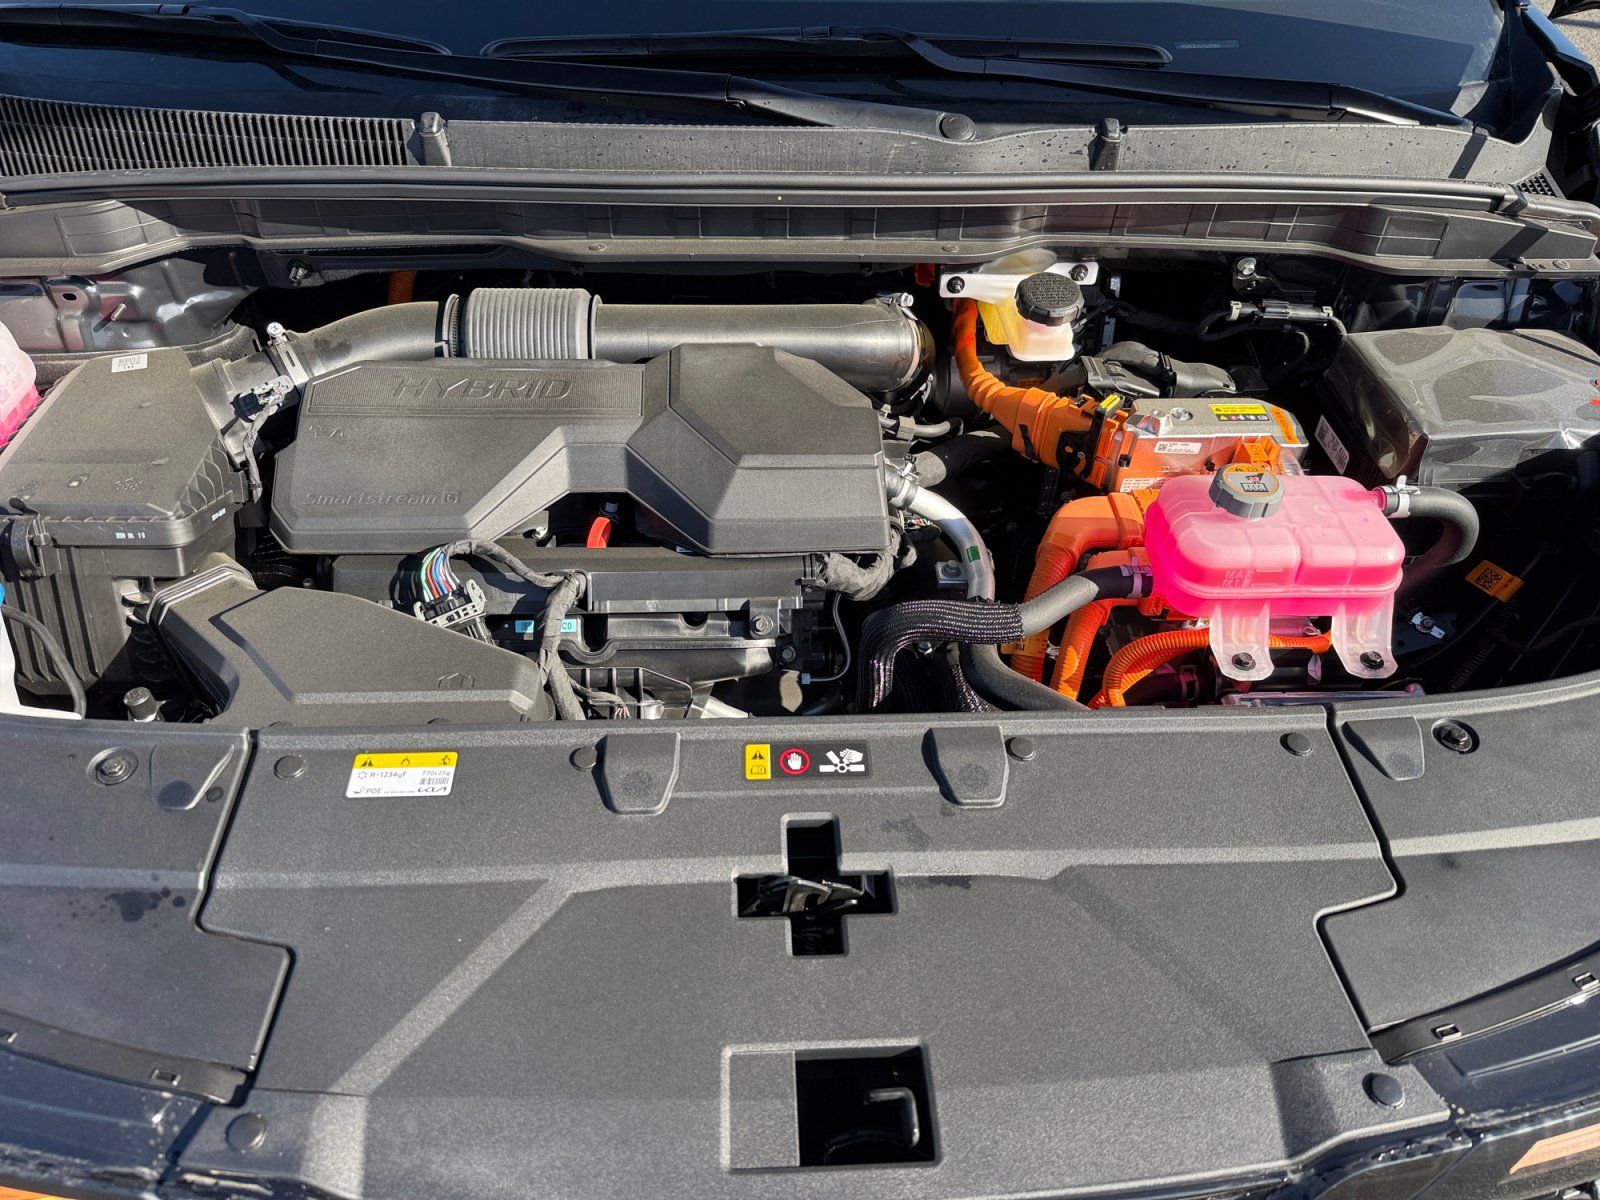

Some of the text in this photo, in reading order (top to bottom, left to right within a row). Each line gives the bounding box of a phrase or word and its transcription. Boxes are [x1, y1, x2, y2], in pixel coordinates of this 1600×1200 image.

[392, 377, 573, 400] HYBRID
[302, 491, 437, 505] Smartstream
[369, 770, 407, 779] R-1234yf
